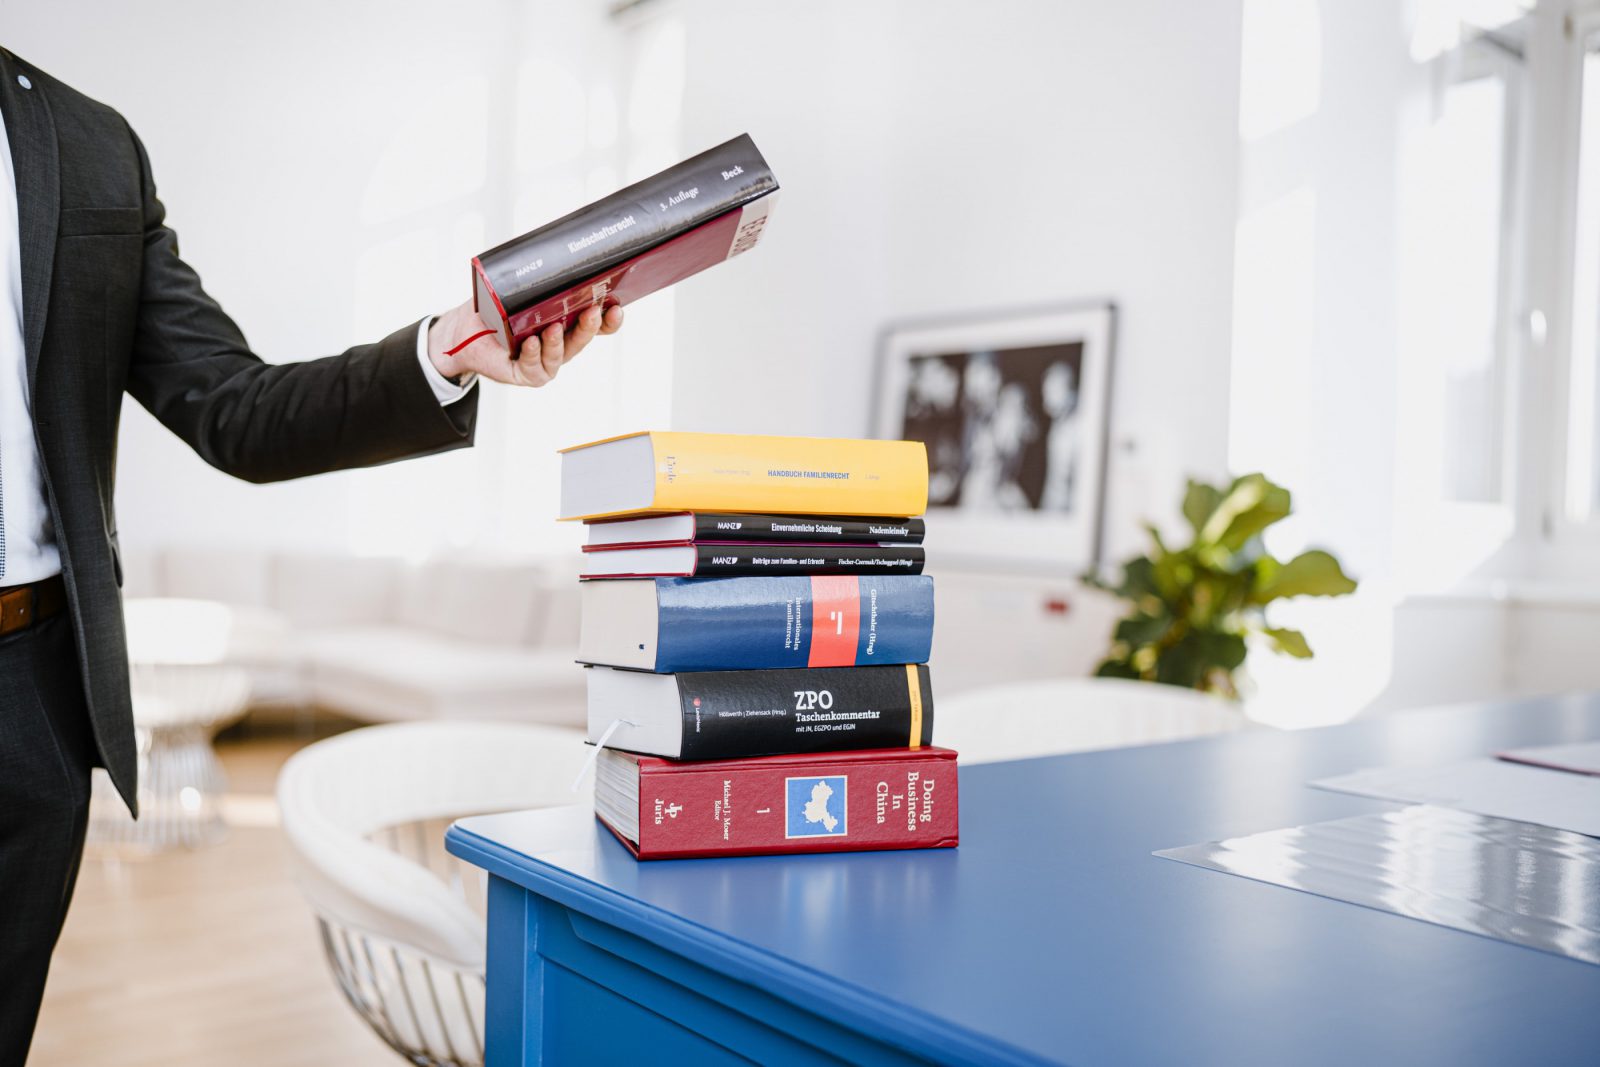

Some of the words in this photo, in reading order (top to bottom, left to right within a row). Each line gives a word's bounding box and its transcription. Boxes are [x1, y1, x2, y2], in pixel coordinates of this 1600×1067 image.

[567, 215, 637, 254] Kindschaftsrecht
[659, 202, 668, 212] 3.
[668, 187, 699, 207] Auflage
[721, 165, 744, 181] Beck
[767, 470, 802, 478] HANDBUCH
[803, 471, 850, 480] FAMILIENRECHT
[717, 522, 737, 530] MANZ
[771, 523, 815, 533] Einvernehmliche
[815, 524, 842, 534] Scheidung
[712, 557, 732, 565] MANZ
[752, 558, 770, 566] Beiträge
[870, 588, 878, 632] Gitschthaler
[784, 599, 794, 649] Familienrecht
[793, 597, 802, 651] Internationales
[866, 632, 877, 655] (Hrsg)
[794, 690, 833, 710] ZPO
[795, 710, 881, 722] Taschenkommentar
[805, 725, 813, 733] JN,
[813, 724, 832, 732] EGZPO
[723, 780, 732, 808] Michael
[876, 781, 889, 824] China
[892, 794, 904, 810] In
[907, 771, 919, 832] Business
[920, 779, 935, 823] Doing
[655, 798, 664, 825] Juris
[723, 817, 731, 840] Moser
